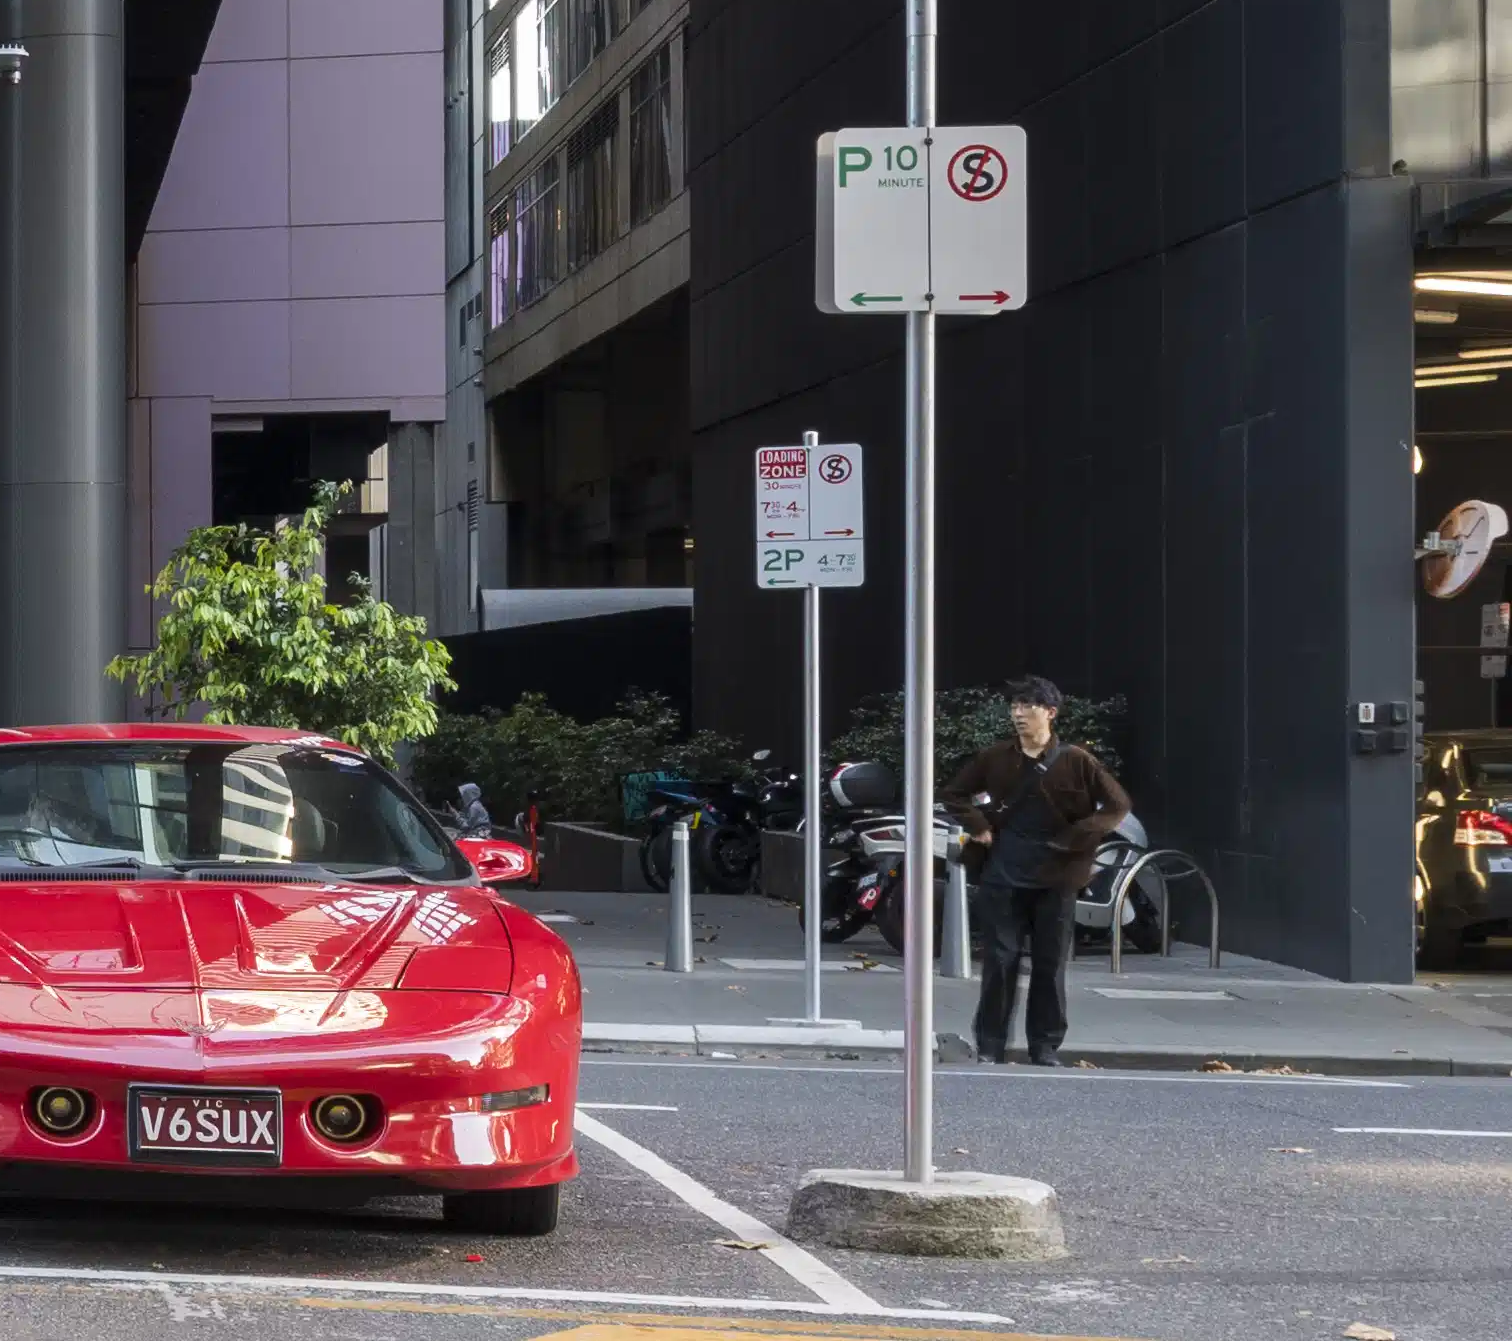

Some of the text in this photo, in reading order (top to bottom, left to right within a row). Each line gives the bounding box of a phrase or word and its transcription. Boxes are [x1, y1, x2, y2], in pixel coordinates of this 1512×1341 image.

[839, 145, 918, 188] P 10
[878, 178, 924, 188] MINUTE
[760, 450, 804, 463] LOADING
[760, 465, 805, 477] ZONE
[764, 482, 779, 490] 30
[764, 549, 804, 571] 2P
[192, 1099, 223, 1108] VIC
[140, 1106, 275, 1145] V6SUX
